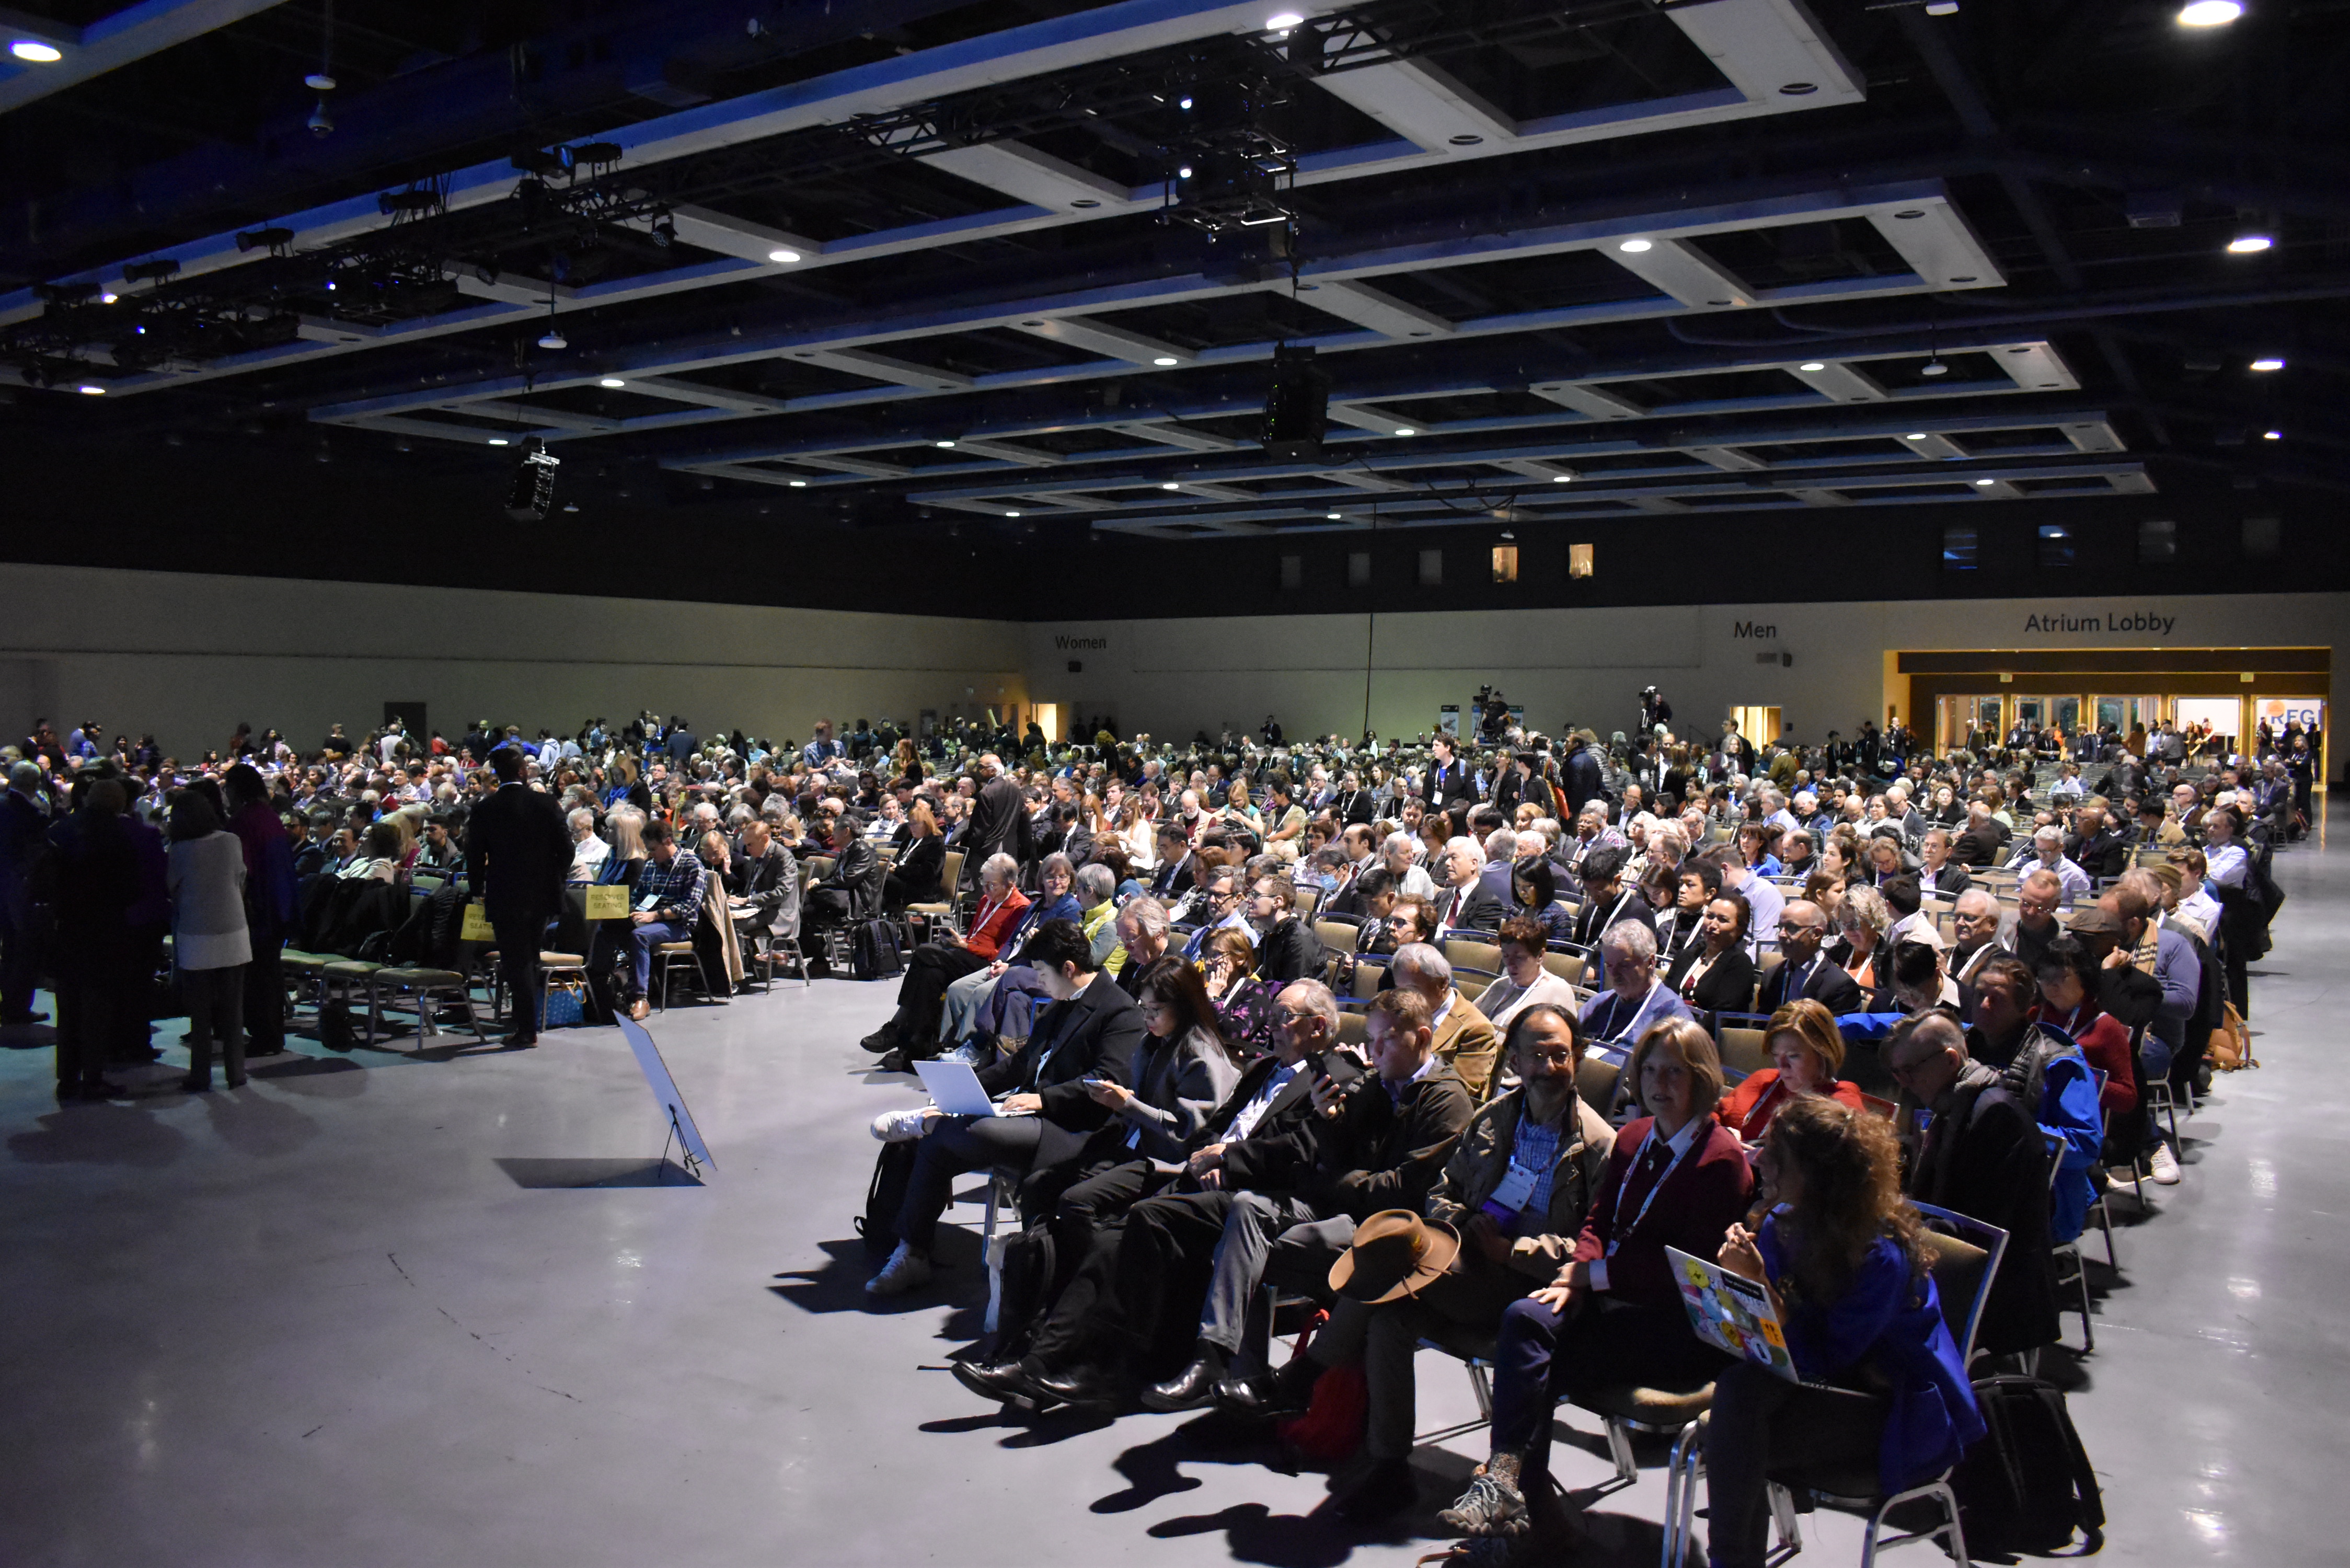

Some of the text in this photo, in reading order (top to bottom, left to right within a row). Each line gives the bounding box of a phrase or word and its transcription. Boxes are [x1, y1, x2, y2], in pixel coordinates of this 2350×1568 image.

[1734, 621, 1776, 638] Men
[2024, 612, 2175, 635] Atrium Lobby
[1055, 635, 1107, 649] Women
